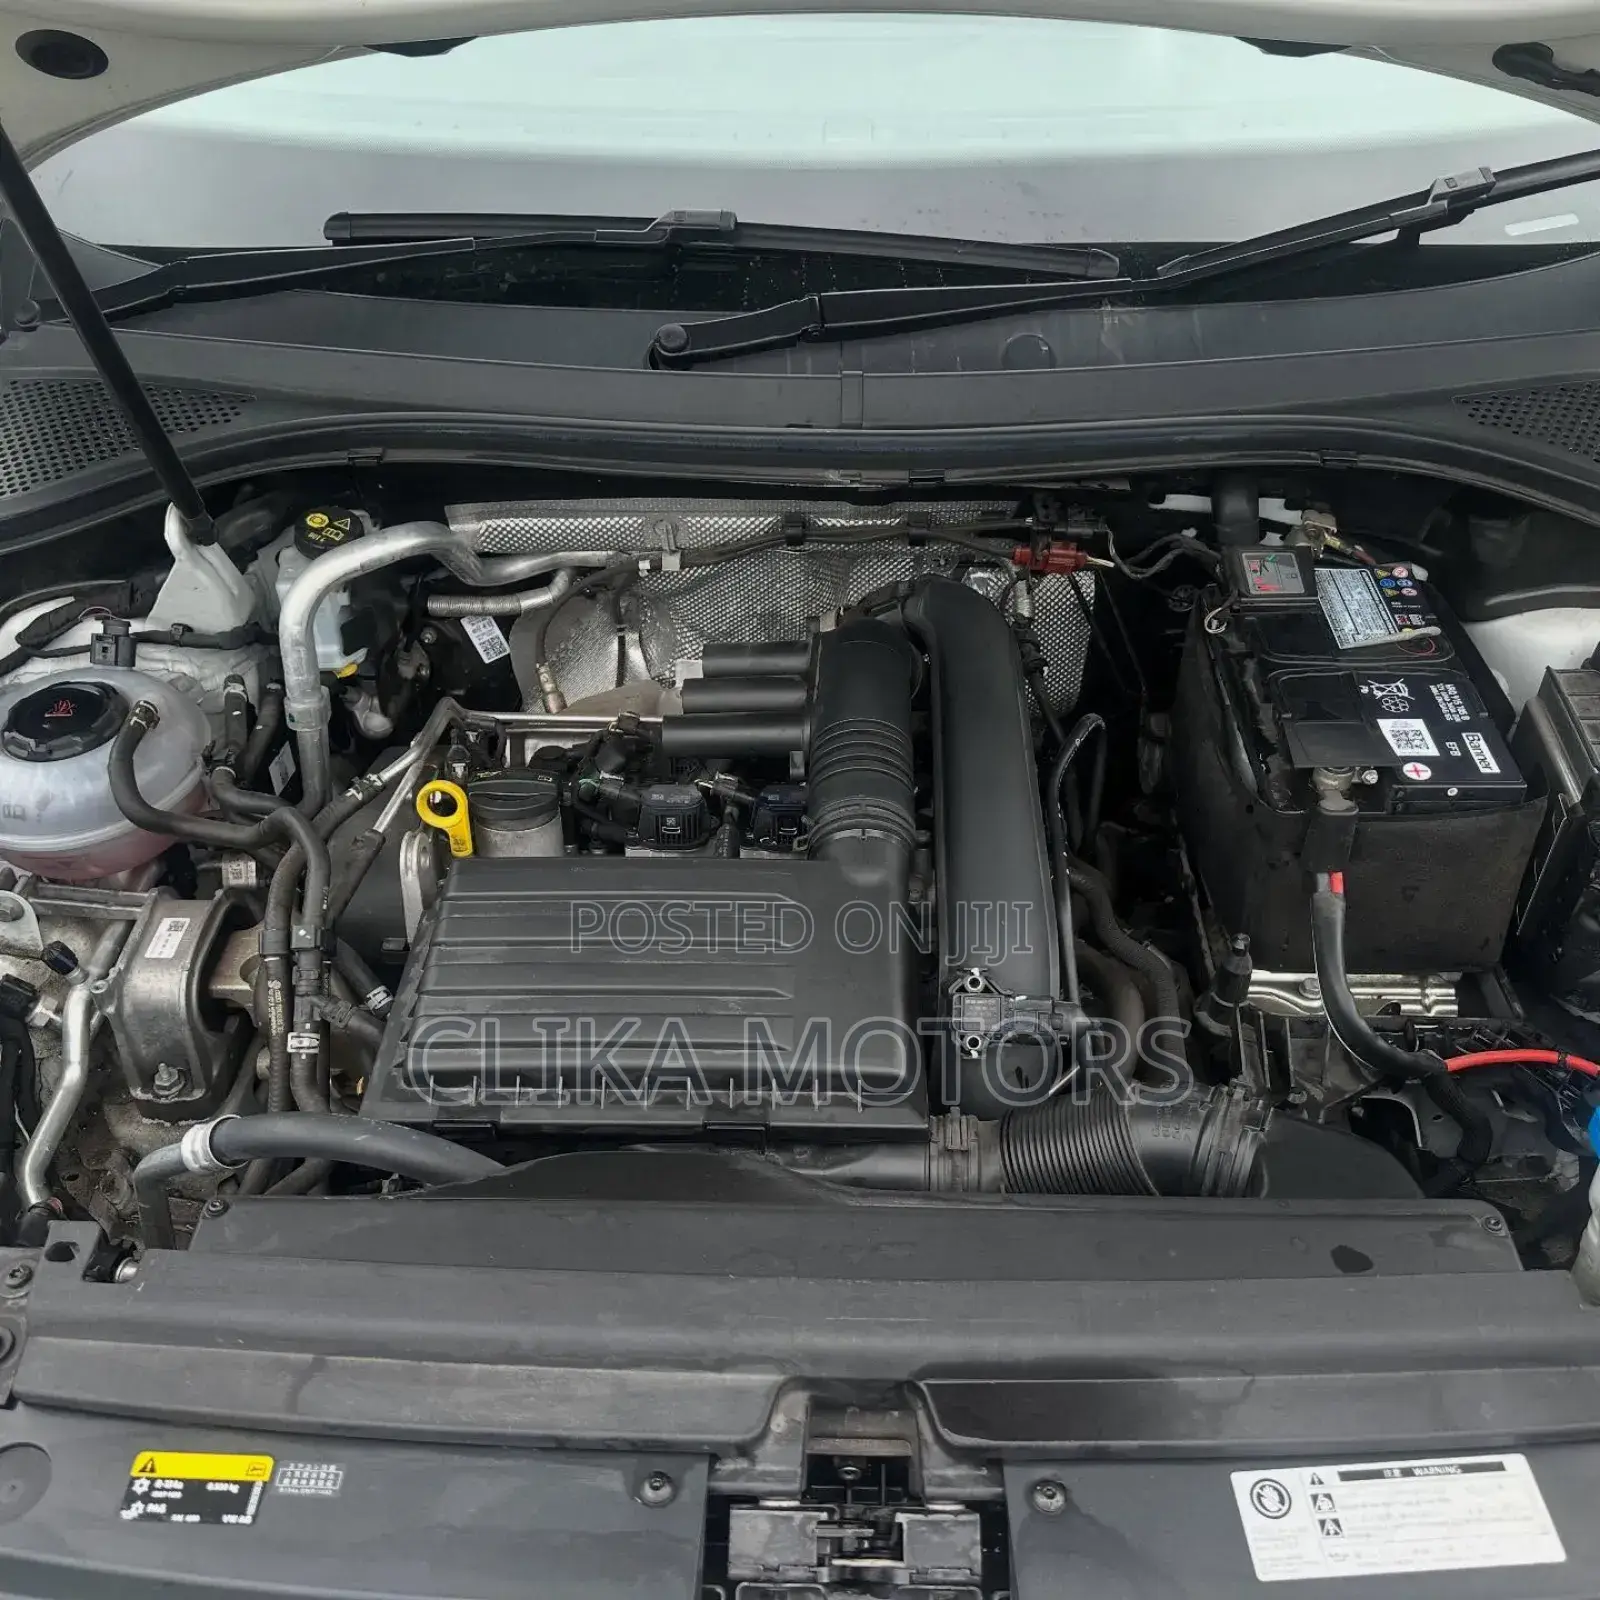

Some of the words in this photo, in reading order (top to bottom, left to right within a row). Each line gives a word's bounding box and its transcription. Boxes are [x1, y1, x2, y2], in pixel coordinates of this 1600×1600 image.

[1446, 742, 1461, 756] EFB
[1465, 734, 1493, 771] Banner
[1411, 1465, 1462, 1477] WARNING
